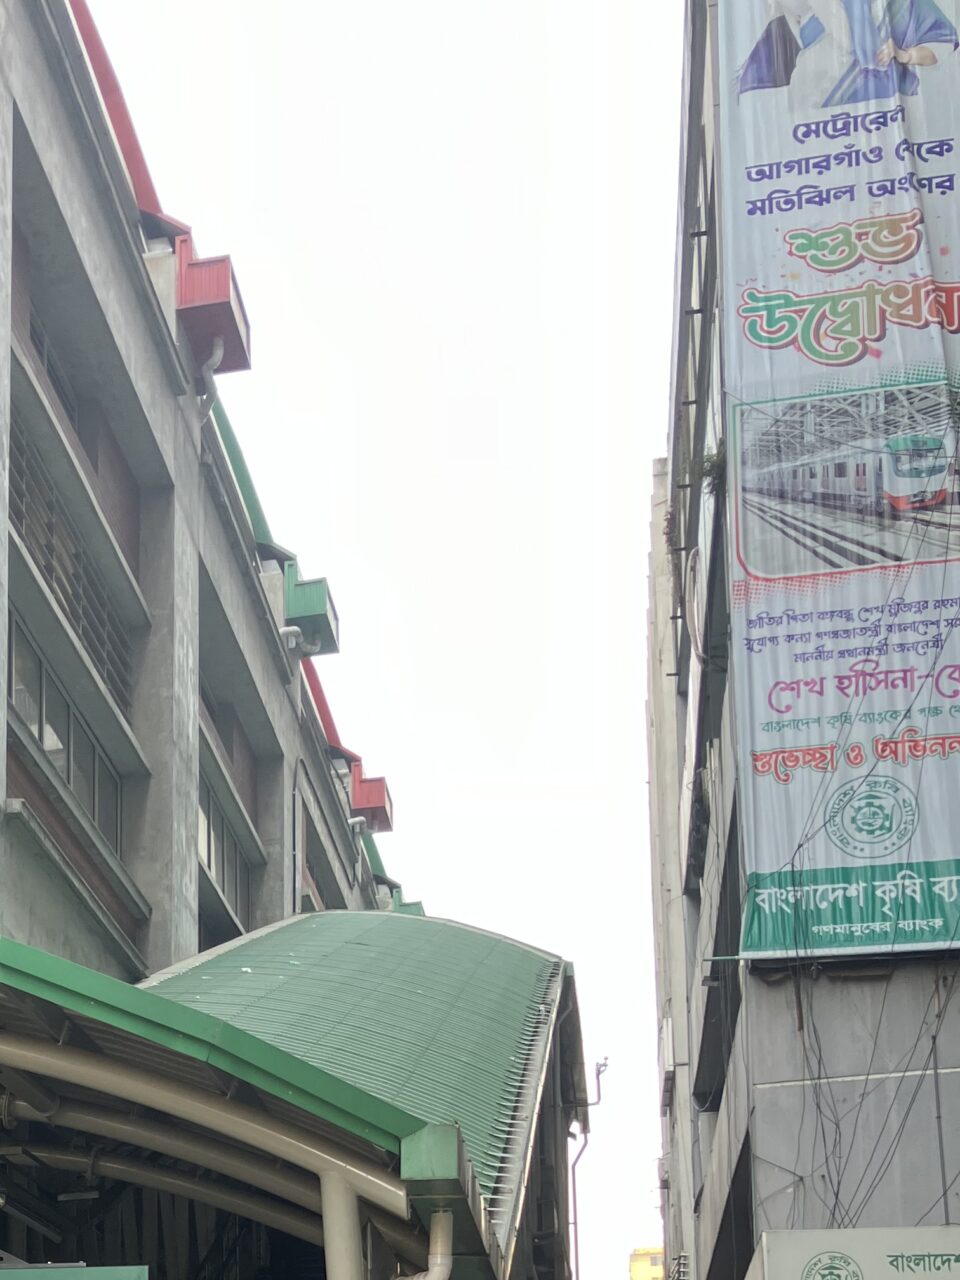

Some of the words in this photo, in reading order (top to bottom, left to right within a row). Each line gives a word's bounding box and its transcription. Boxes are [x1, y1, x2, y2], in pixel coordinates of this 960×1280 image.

[745, 143, 884, 183] আগারগাঁও
[746, 183, 856, 215] মতিঝিল
[785, 210, 924, 272] শুভ
[738, 278, 960, 366] উদ্বোধন
[786, 609, 813, 625] পিতা
[857, 605, 884, 622] শেখ
[768, 677, 827, 713] শেখ
[760, 717, 822, 733] বাংলাদেশ
[827, 712, 854, 727] কৃষি
[751, 743, 838, 783] শুভেচ্ছা
[845, 742, 865, 768] ও
[755, 880, 867, 916] বাংলাদেশ
[872, 870, 924, 918] কৃষি
[897, 918, 945, 932] ব্যাংক
